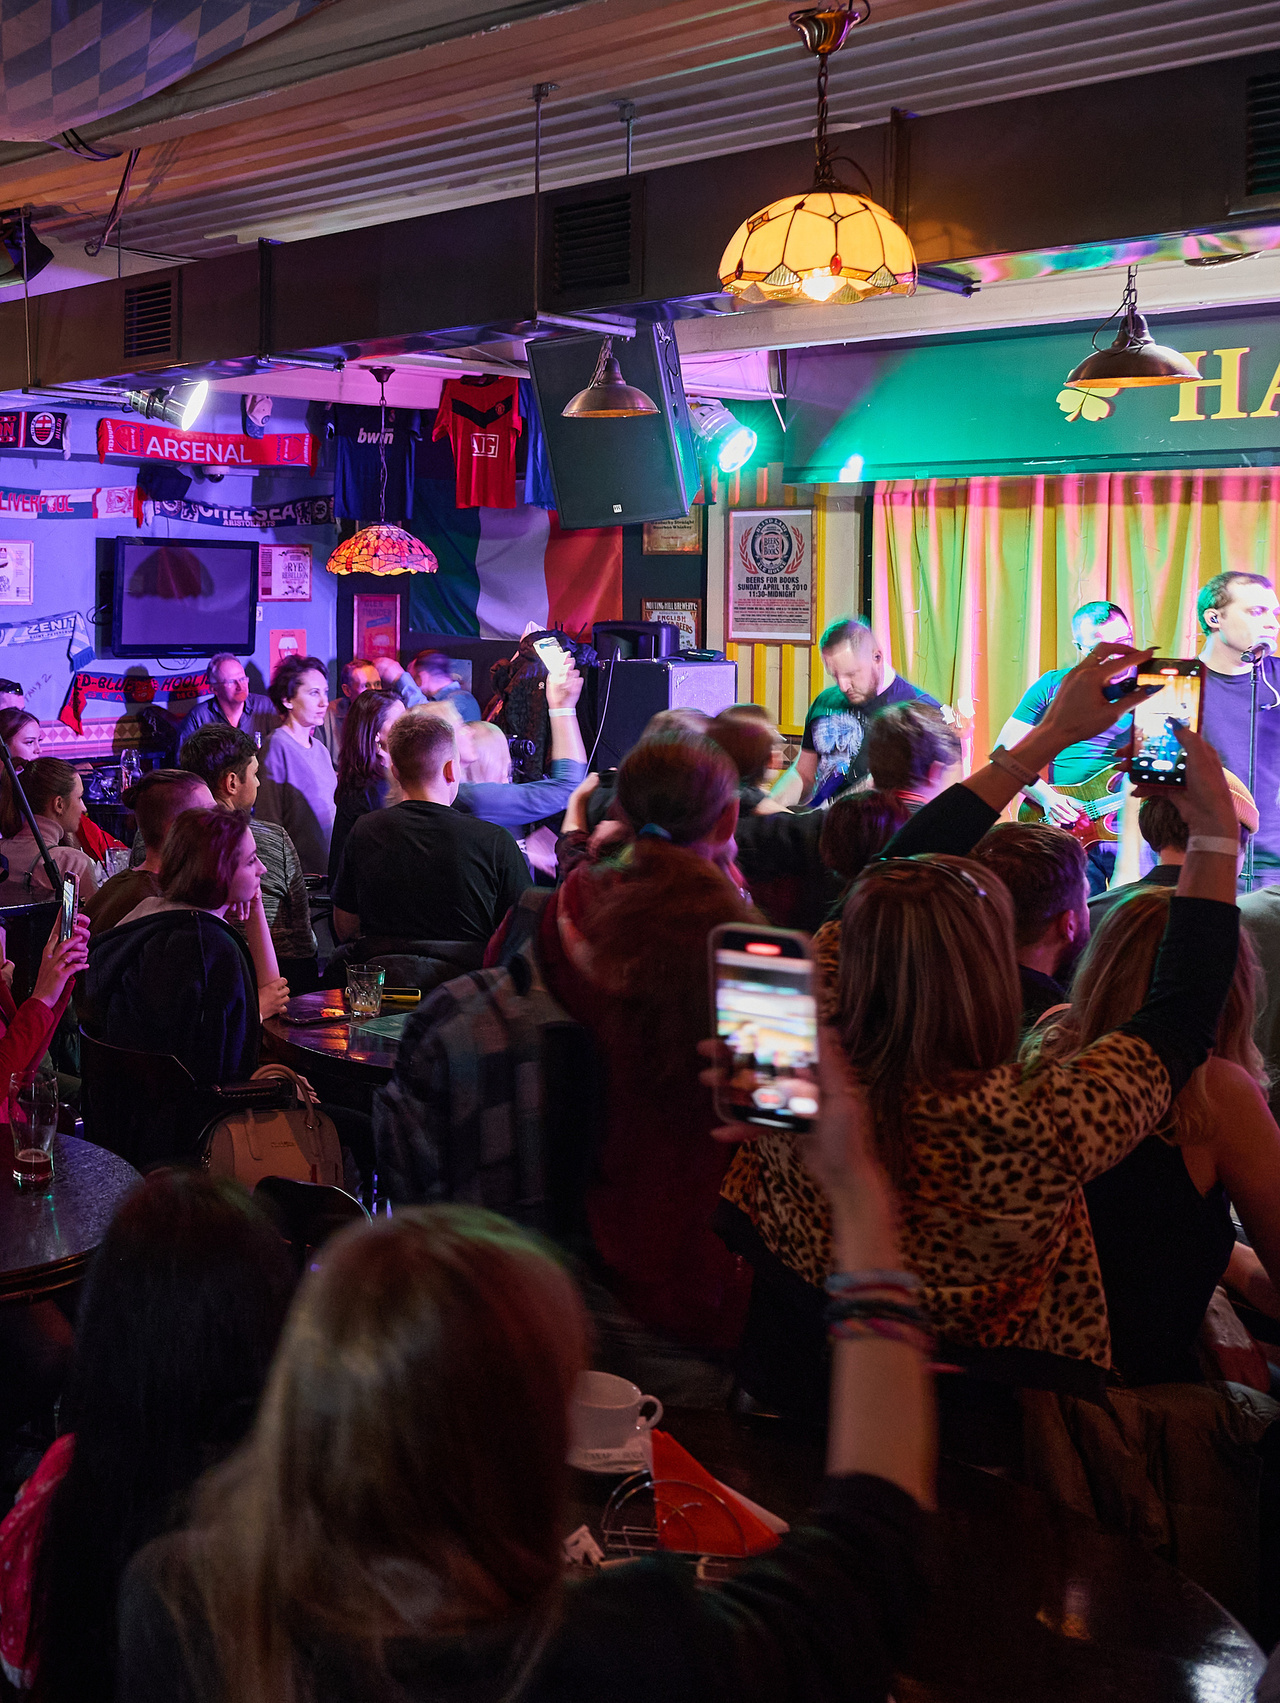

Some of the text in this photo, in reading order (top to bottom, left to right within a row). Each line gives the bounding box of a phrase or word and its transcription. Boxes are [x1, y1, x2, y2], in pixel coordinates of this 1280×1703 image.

[146, 436, 252, 464] ARSENAL
[471, 436, 496, 455] AIG
[198, 504, 296, 521] CHELSEA
[763, 537, 780, 547] BEERS
[763, 547, 780, 556] BOOKS
[27, 617, 76, 634] ZENIT
